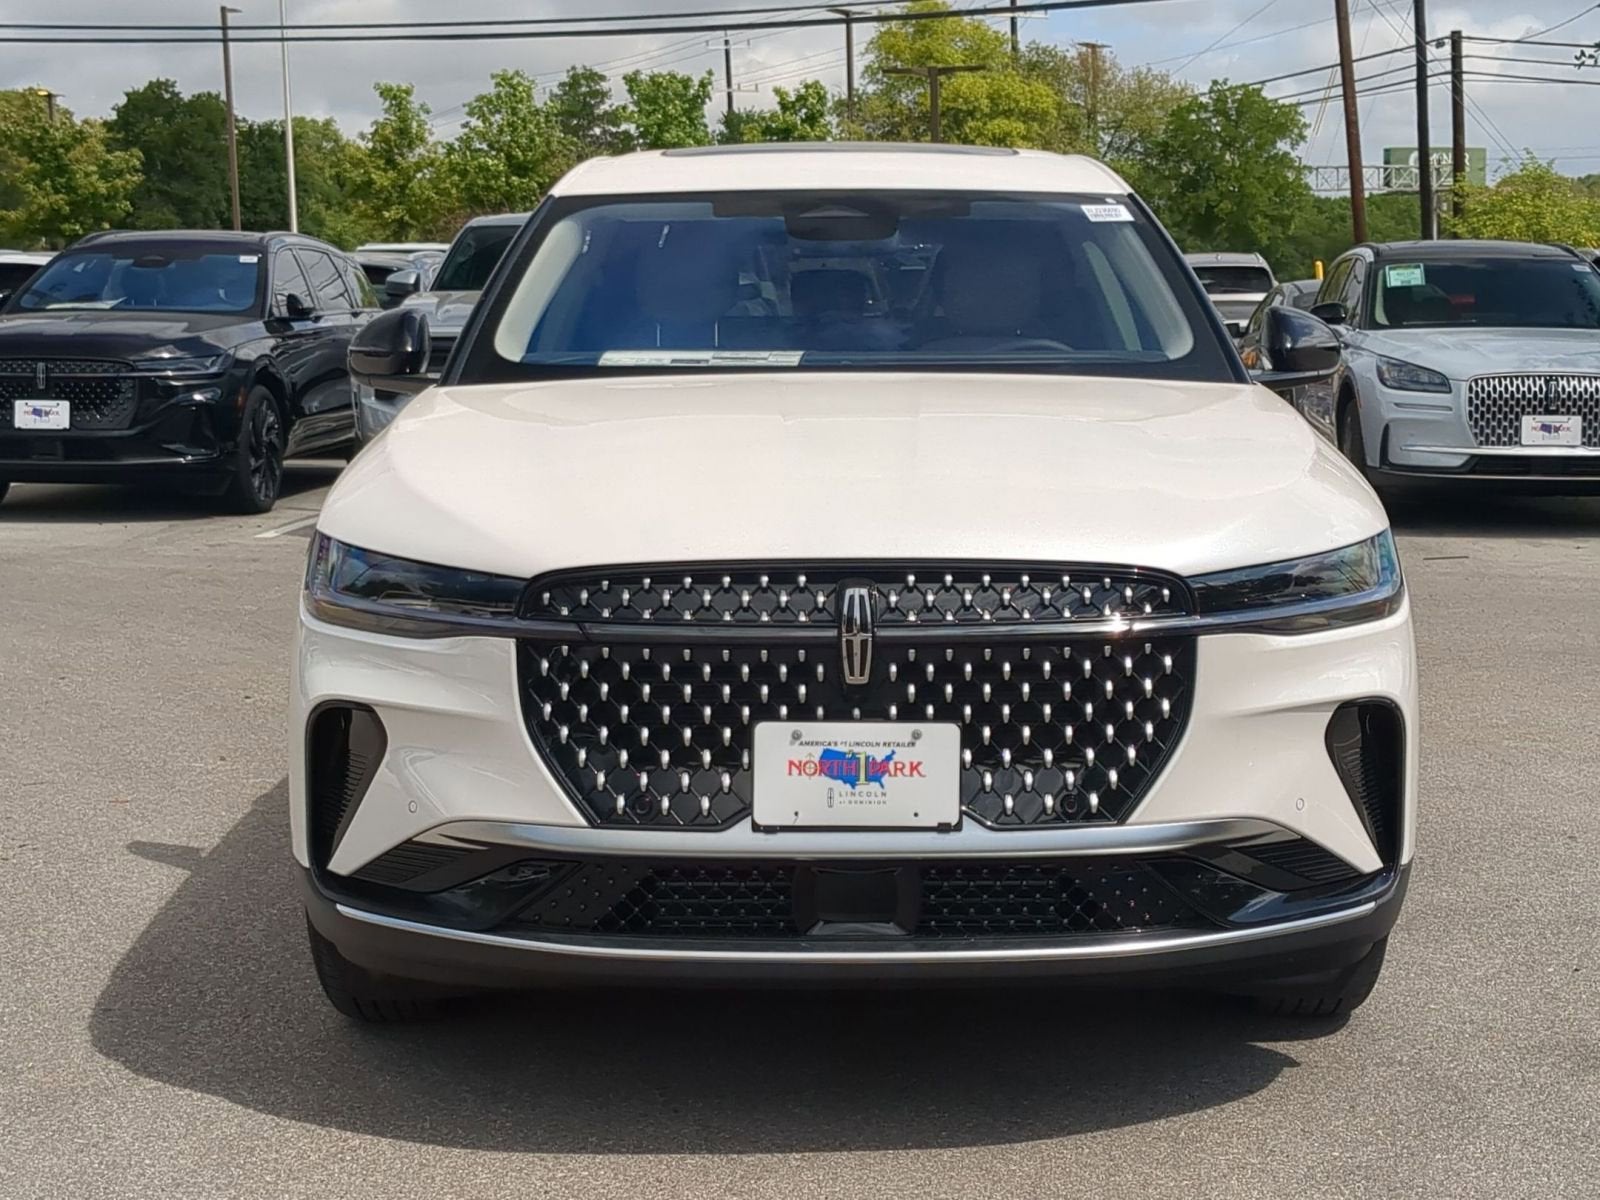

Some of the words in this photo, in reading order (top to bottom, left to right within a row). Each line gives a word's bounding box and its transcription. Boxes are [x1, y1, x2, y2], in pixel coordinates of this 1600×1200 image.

[798, 740, 838, 748] AMERICA'S
[883, 740, 917, 748] RETAILER
[787, 759, 858, 777] NORTH
[869, 760, 927, 778] PARK
